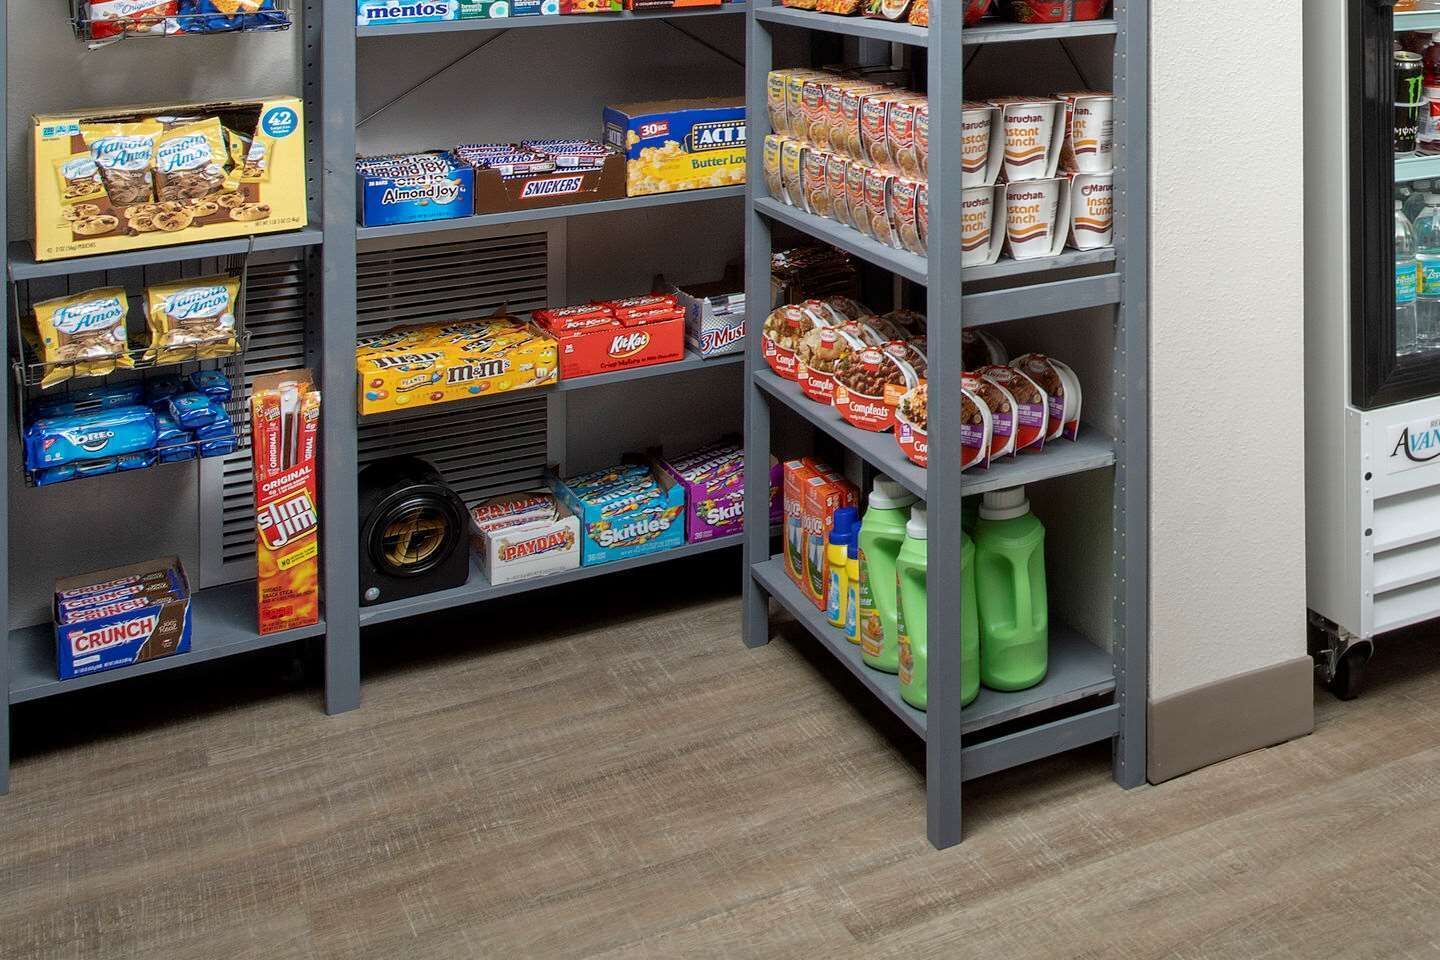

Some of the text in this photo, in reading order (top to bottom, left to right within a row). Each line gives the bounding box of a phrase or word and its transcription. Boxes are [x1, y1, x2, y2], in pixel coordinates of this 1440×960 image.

[367, 2, 448, 19] mentos
[269, 110, 292, 126] 42
[1005, 115, 1042, 124] aruchan
[642, 123, 657, 136] 30
[700, 128, 735, 144] ACT
[1005, 128, 1039, 136] nstant
[106, 149, 152, 169] Amos
[692, 156, 729, 170] Butter
[383, 186, 458, 204] Almond Joy
[525, 178, 582, 196] SNICKERS
[1007, 192, 1044, 201] aruchan
[1008, 204, 1040, 213] stant
[1089, 208, 1113, 216] Lunc
[1008, 215, 1036, 224] unch
[179, 294, 228, 319] Amos
[69, 308, 122, 334] Amos
[601, 360, 616, 368] Crisp
[402, 375, 427, 387] PEANUT
[850, 400, 890, 417] Compleats
[262, 466, 312, 492] ORIGINAL
[599, 518, 671, 547] Skittles
[506, 531, 567, 560] PAYDAY
[75, 618, 153, 652] CRUNCH
